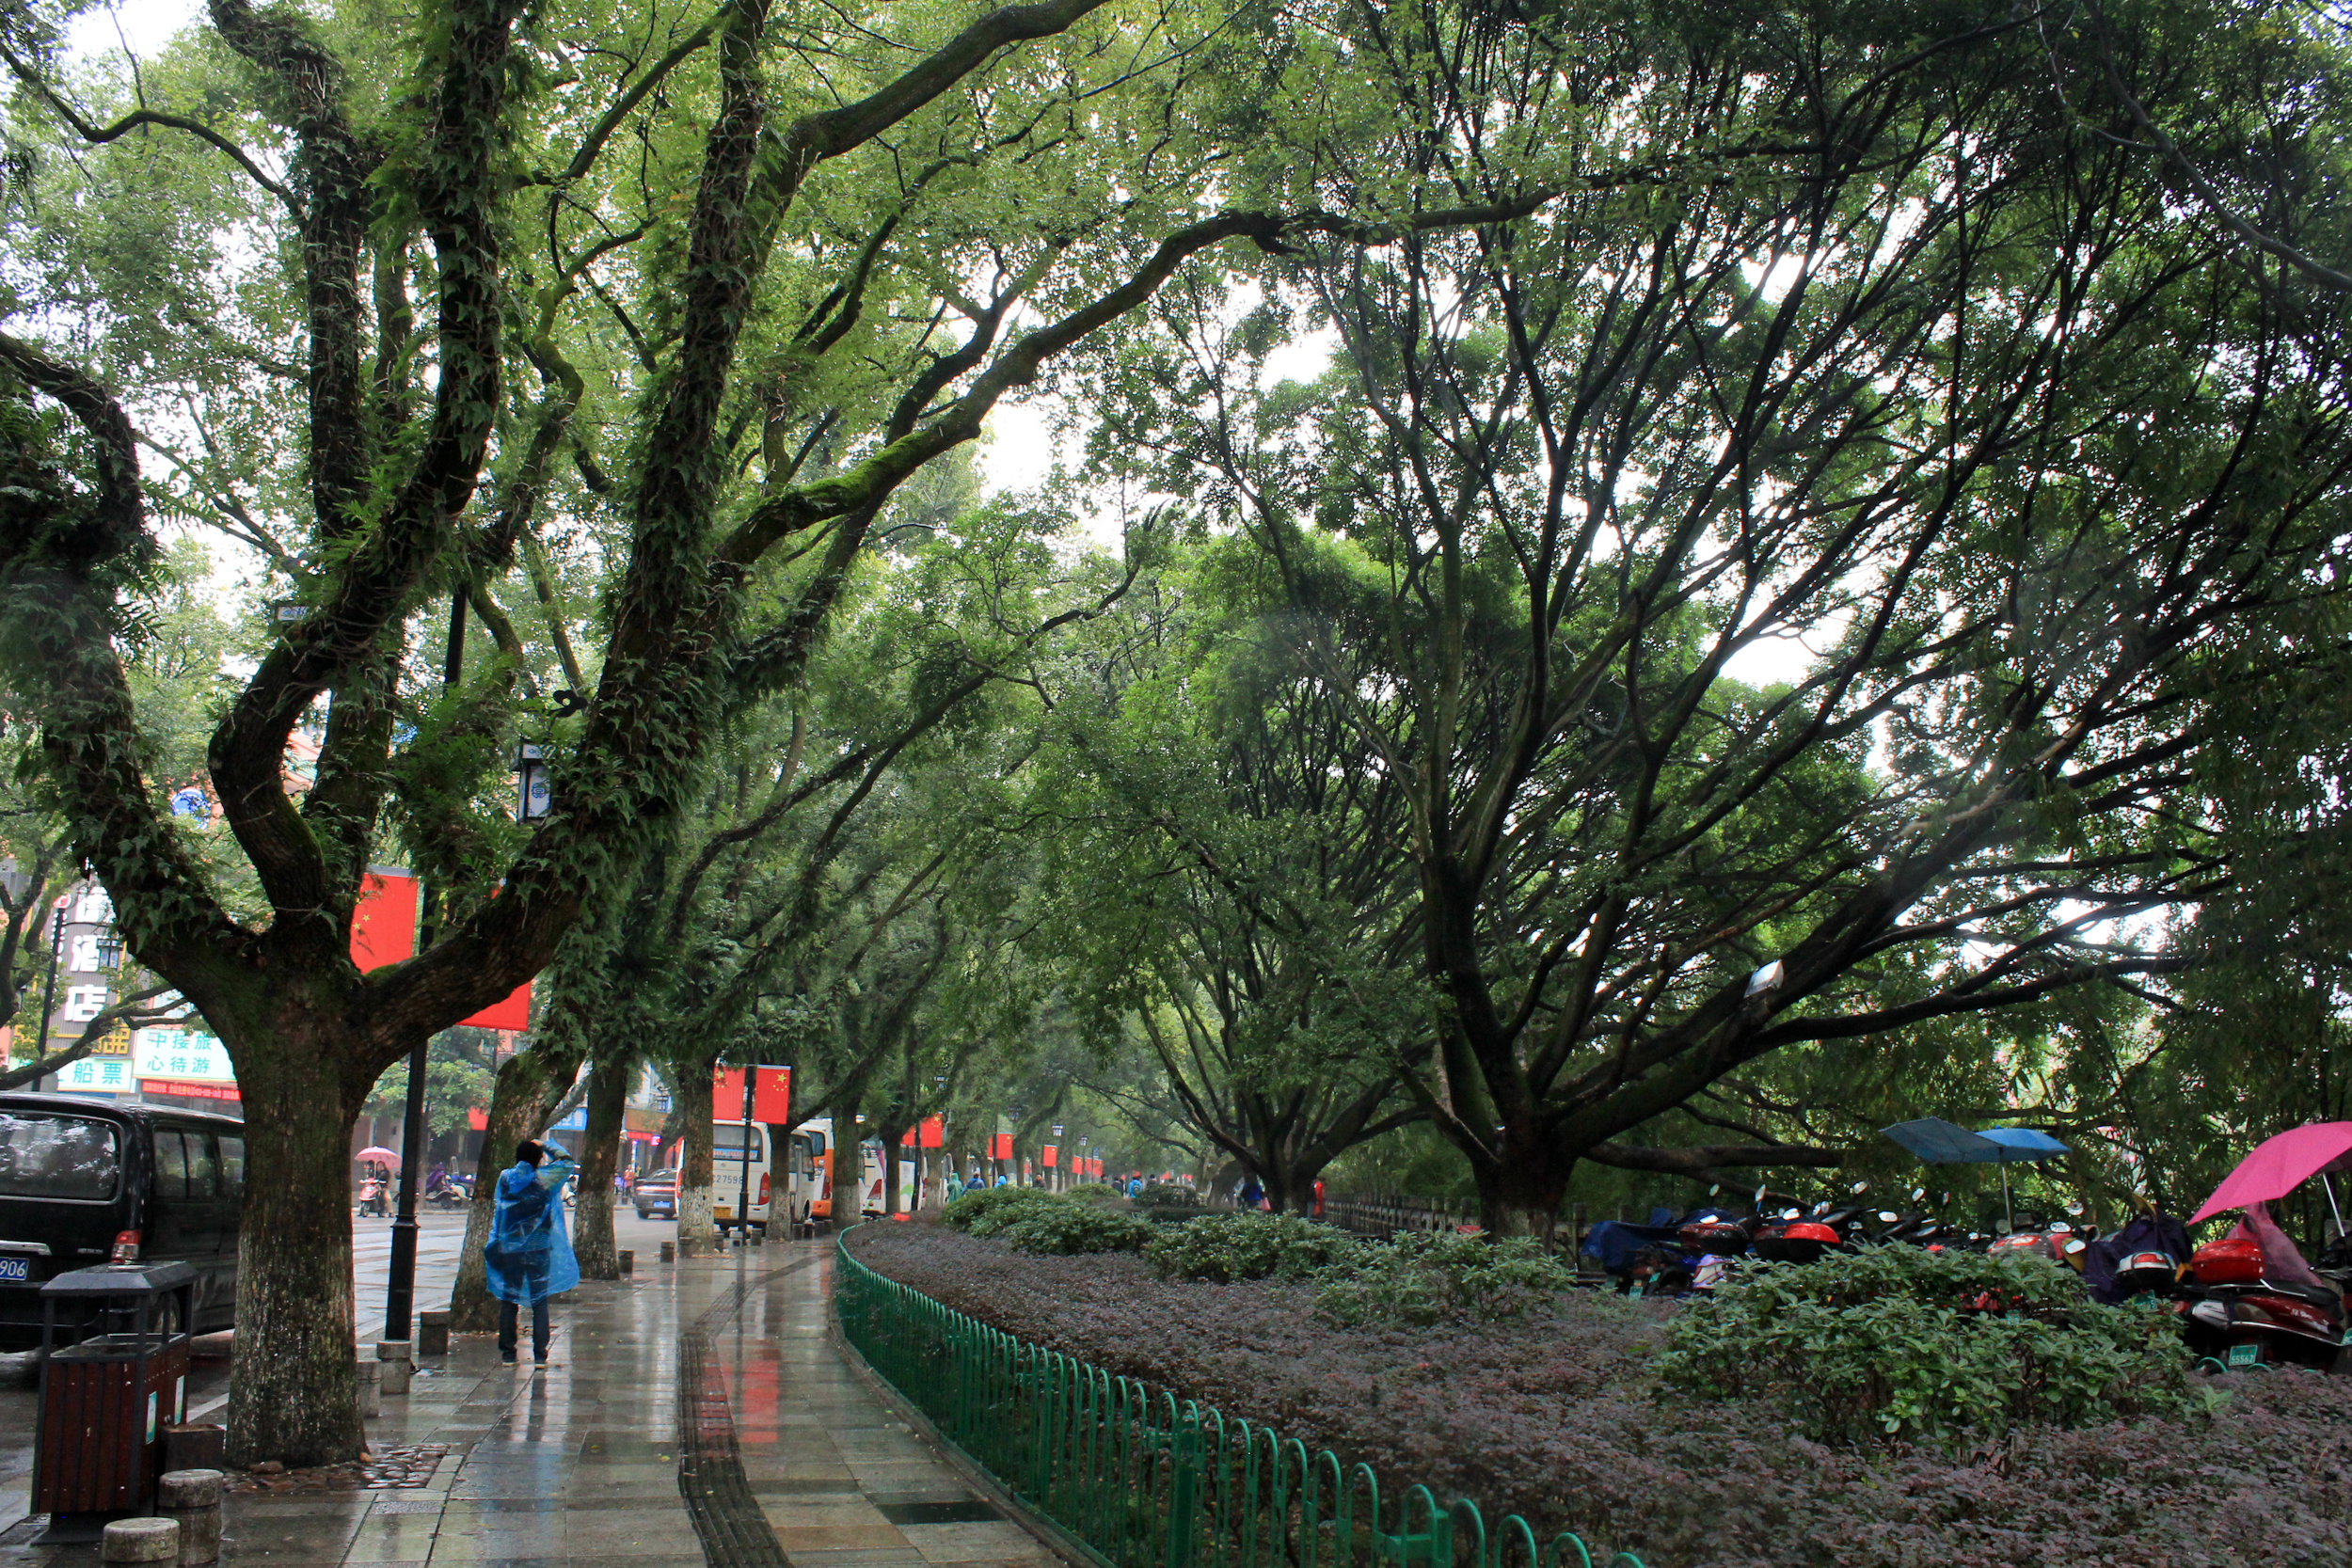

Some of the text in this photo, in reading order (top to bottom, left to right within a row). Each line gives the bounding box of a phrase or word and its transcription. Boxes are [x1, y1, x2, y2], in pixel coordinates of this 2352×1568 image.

[57, 1062, 123, 1085] 船票
[0, 1260, 25, 1276] 906
[2231, 1354, 2254, 1364] 55562
